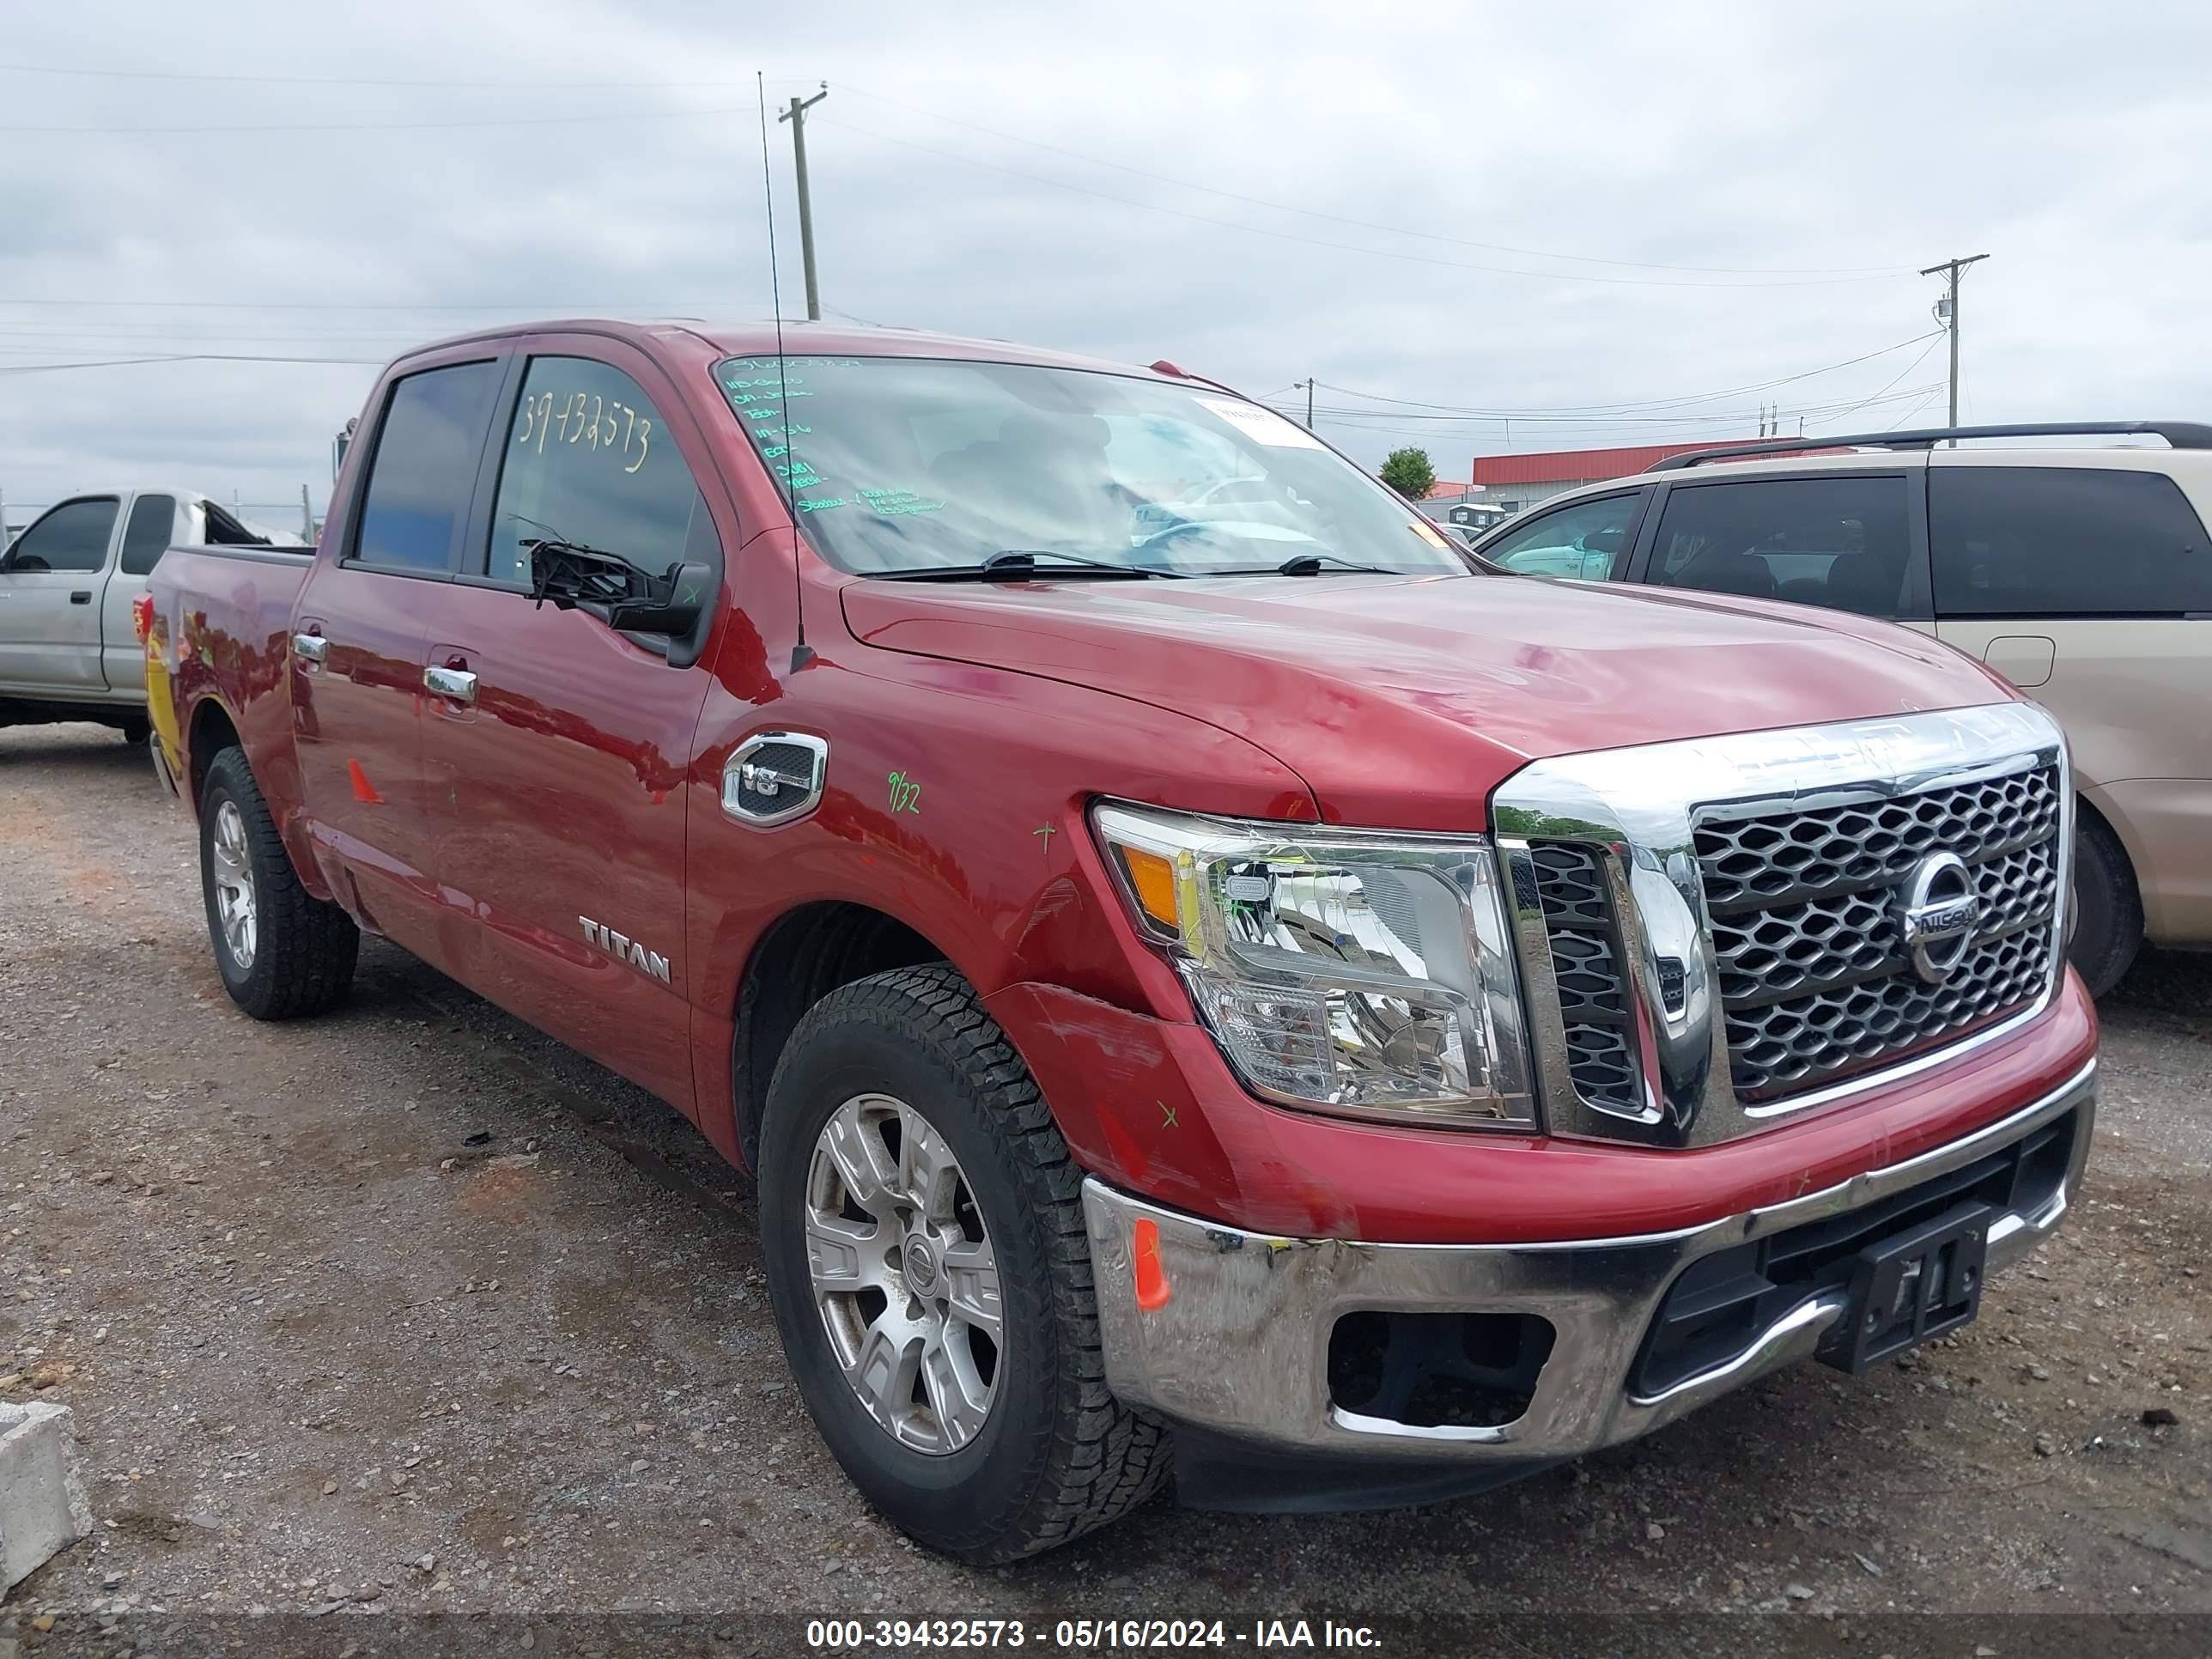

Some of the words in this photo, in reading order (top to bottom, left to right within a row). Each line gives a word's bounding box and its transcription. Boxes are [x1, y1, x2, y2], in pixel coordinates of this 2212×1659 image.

[742, 763, 779, 796] V8
[1920, 904, 1978, 935] NISSAN
[578, 915, 672, 985] TITAN
